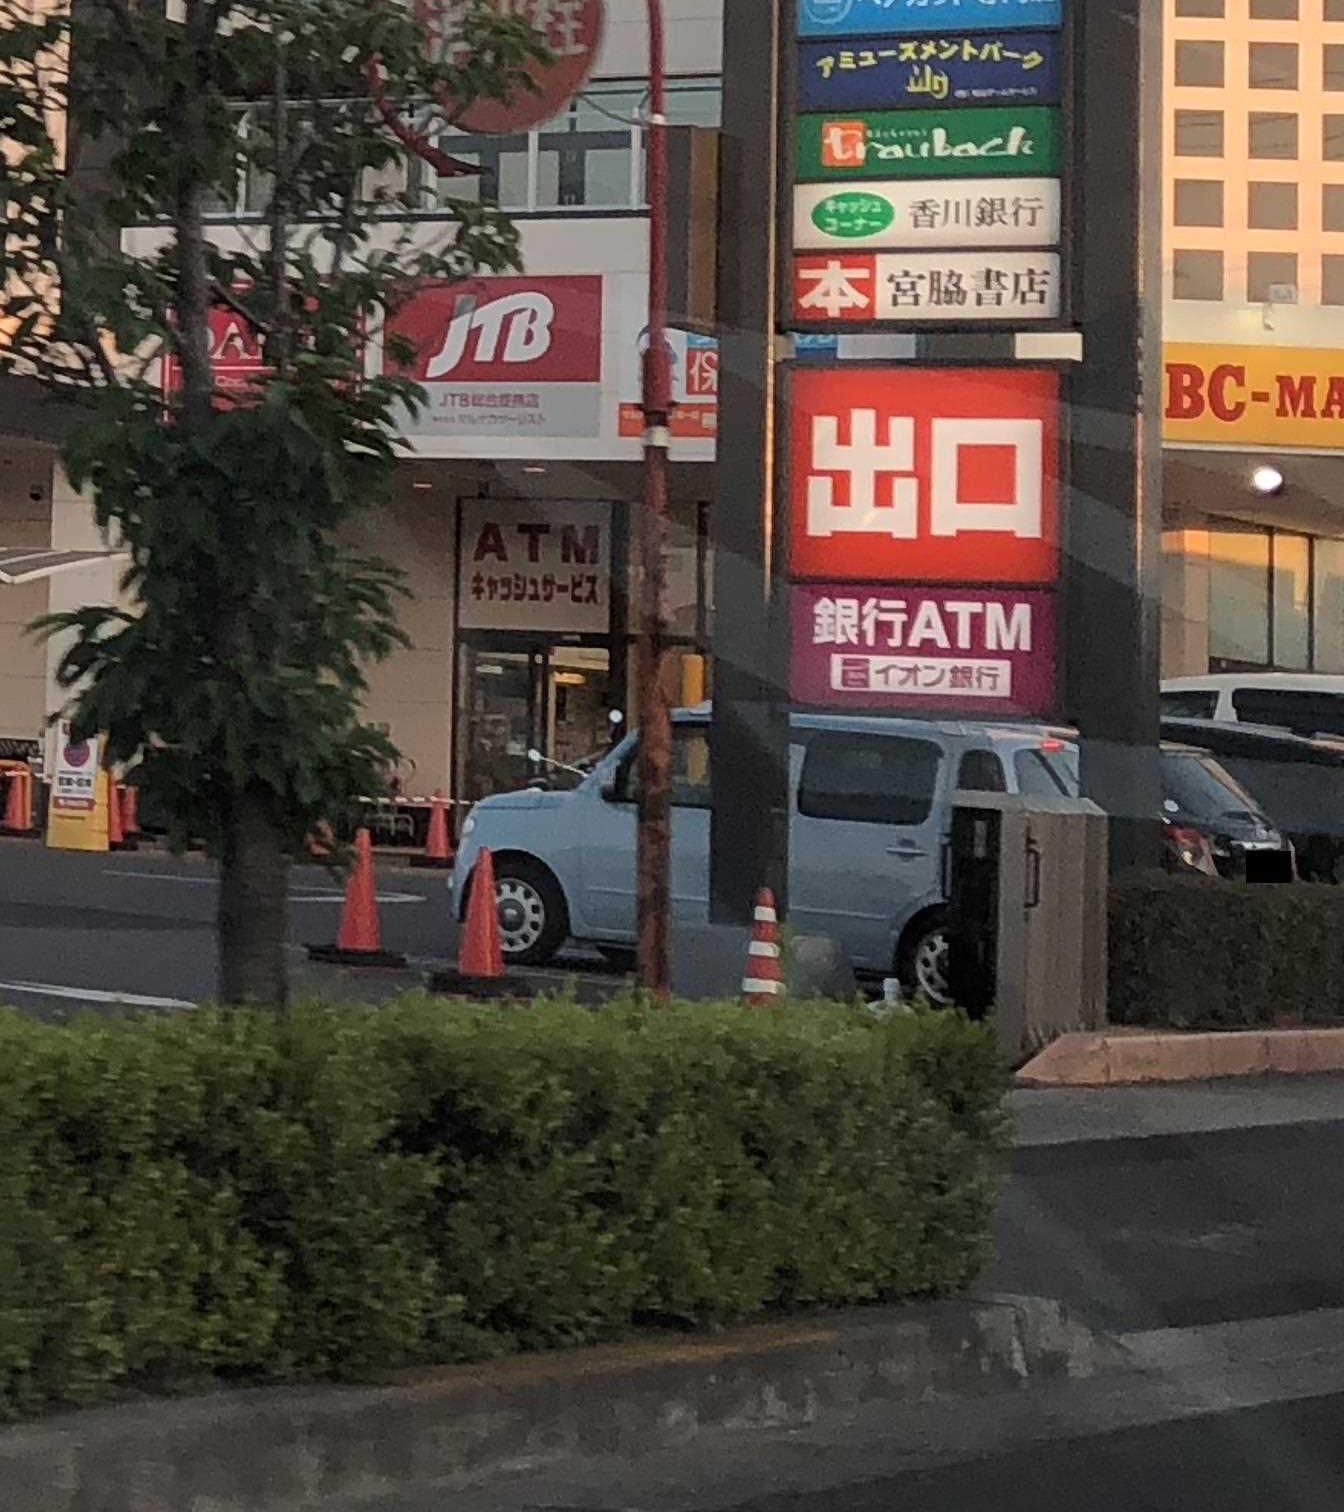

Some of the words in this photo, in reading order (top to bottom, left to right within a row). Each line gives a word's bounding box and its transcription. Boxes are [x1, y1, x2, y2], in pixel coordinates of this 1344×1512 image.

[909, 195, 1044, 230] 香川銀行
[798, 260, 871, 318] 本
[886, 267, 1052, 308] 宮脇書店
[425, 291, 554, 378] JTB
[807, 408, 1043, 539] 出口
[472, 521, 601, 565] ATM
[471, 573, 599, 604] キャッシュサービス
[813, 597, 1032, 652] 銀行ATM
[875, 663, 1001, 690] イオン銀行
